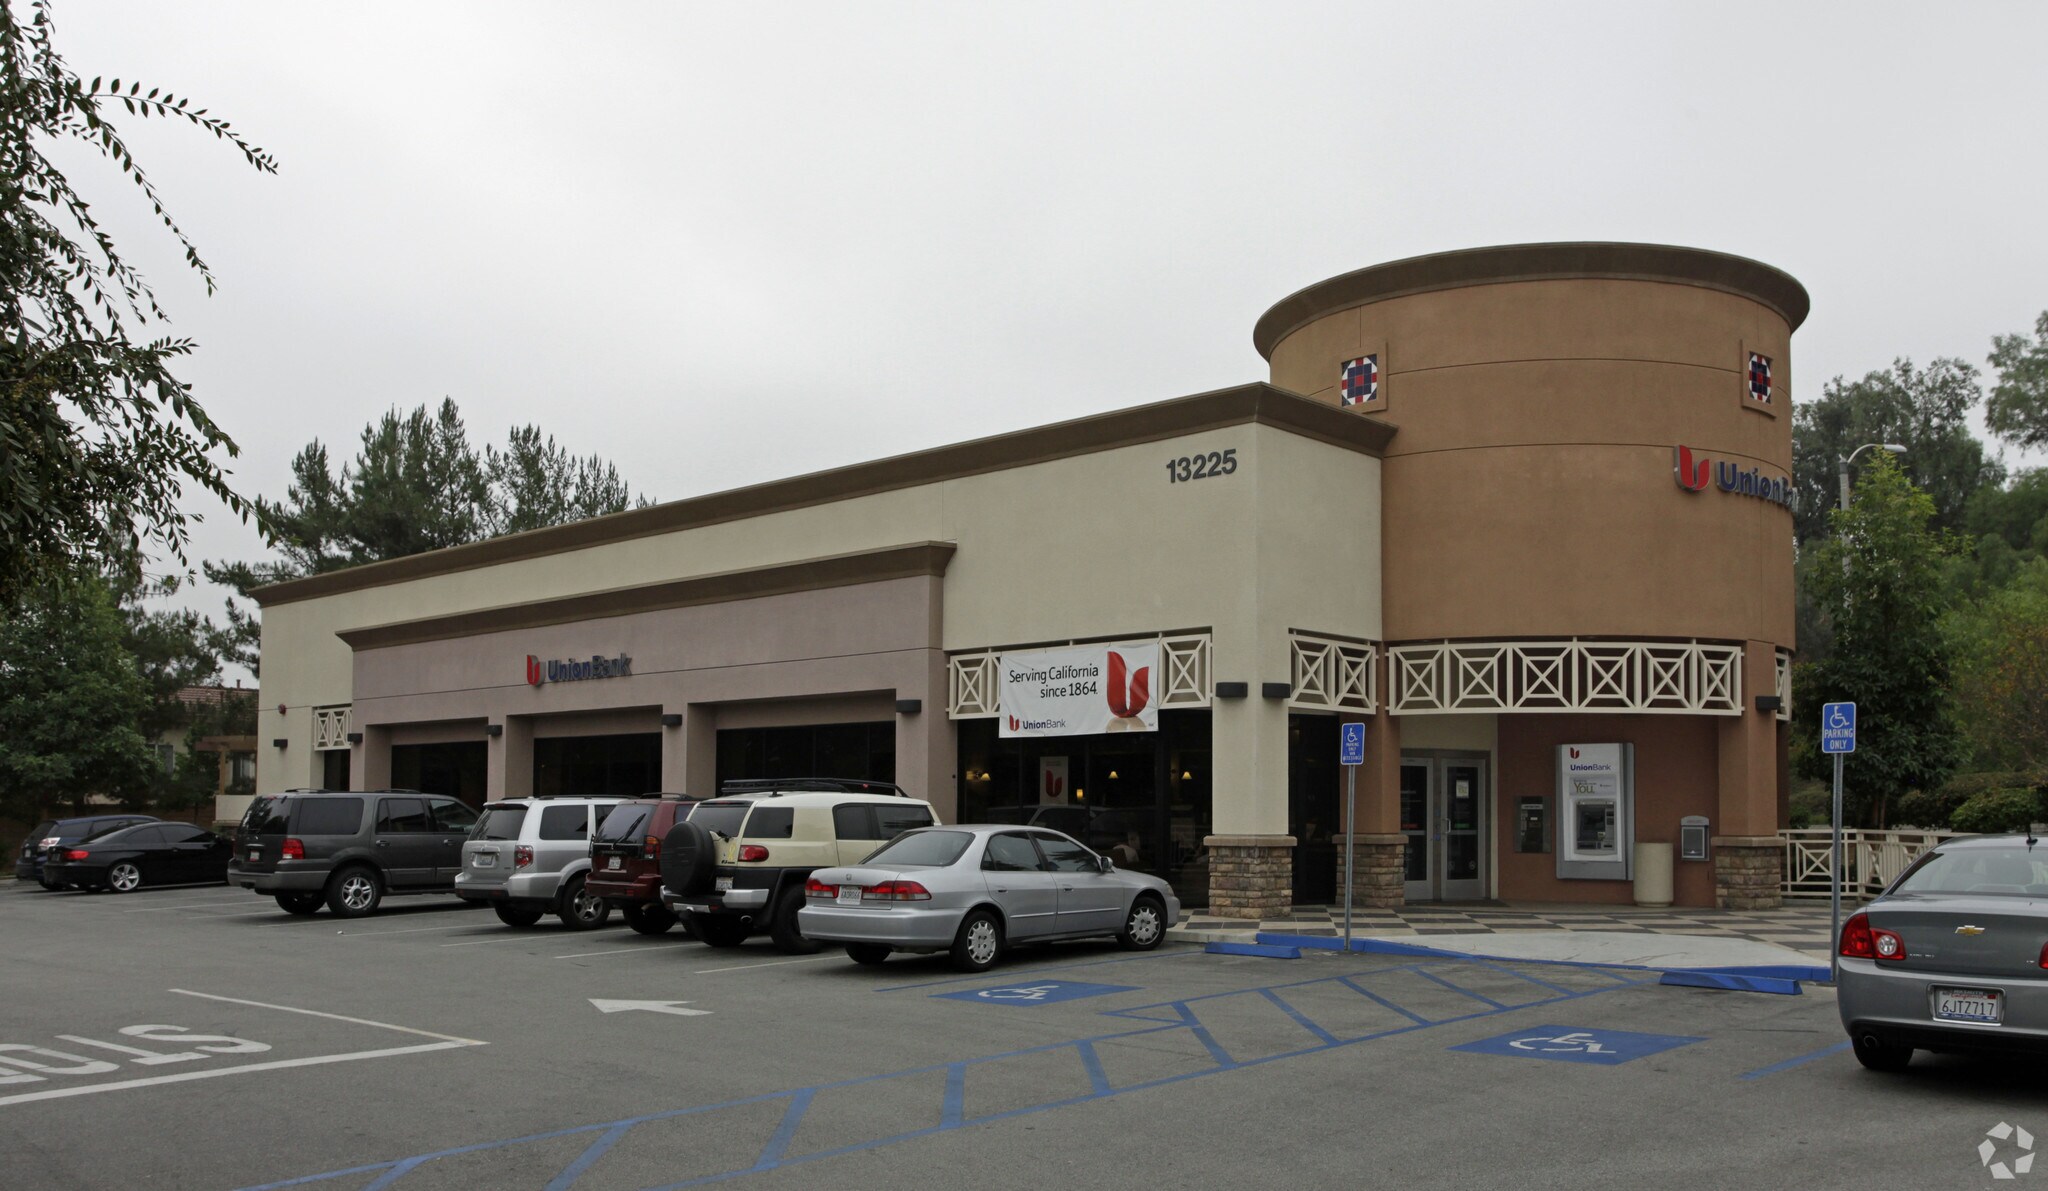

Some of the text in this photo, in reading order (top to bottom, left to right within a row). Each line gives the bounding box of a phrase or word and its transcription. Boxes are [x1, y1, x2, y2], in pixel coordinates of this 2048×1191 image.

[1166, 448, 1238, 484] 13225
[548, 653, 632, 682] UnionBank
[1009, 663, 1099, 684] Serving California
[1040, 685, 1067, 698] since
[1022, 718, 1066, 730] UnionBank
[1824, 728, 1853, 738] PARKING
[1830, 740, 1847, 750] ONLY
[1942, 1000, 1995, 1016] 6JTZ717
